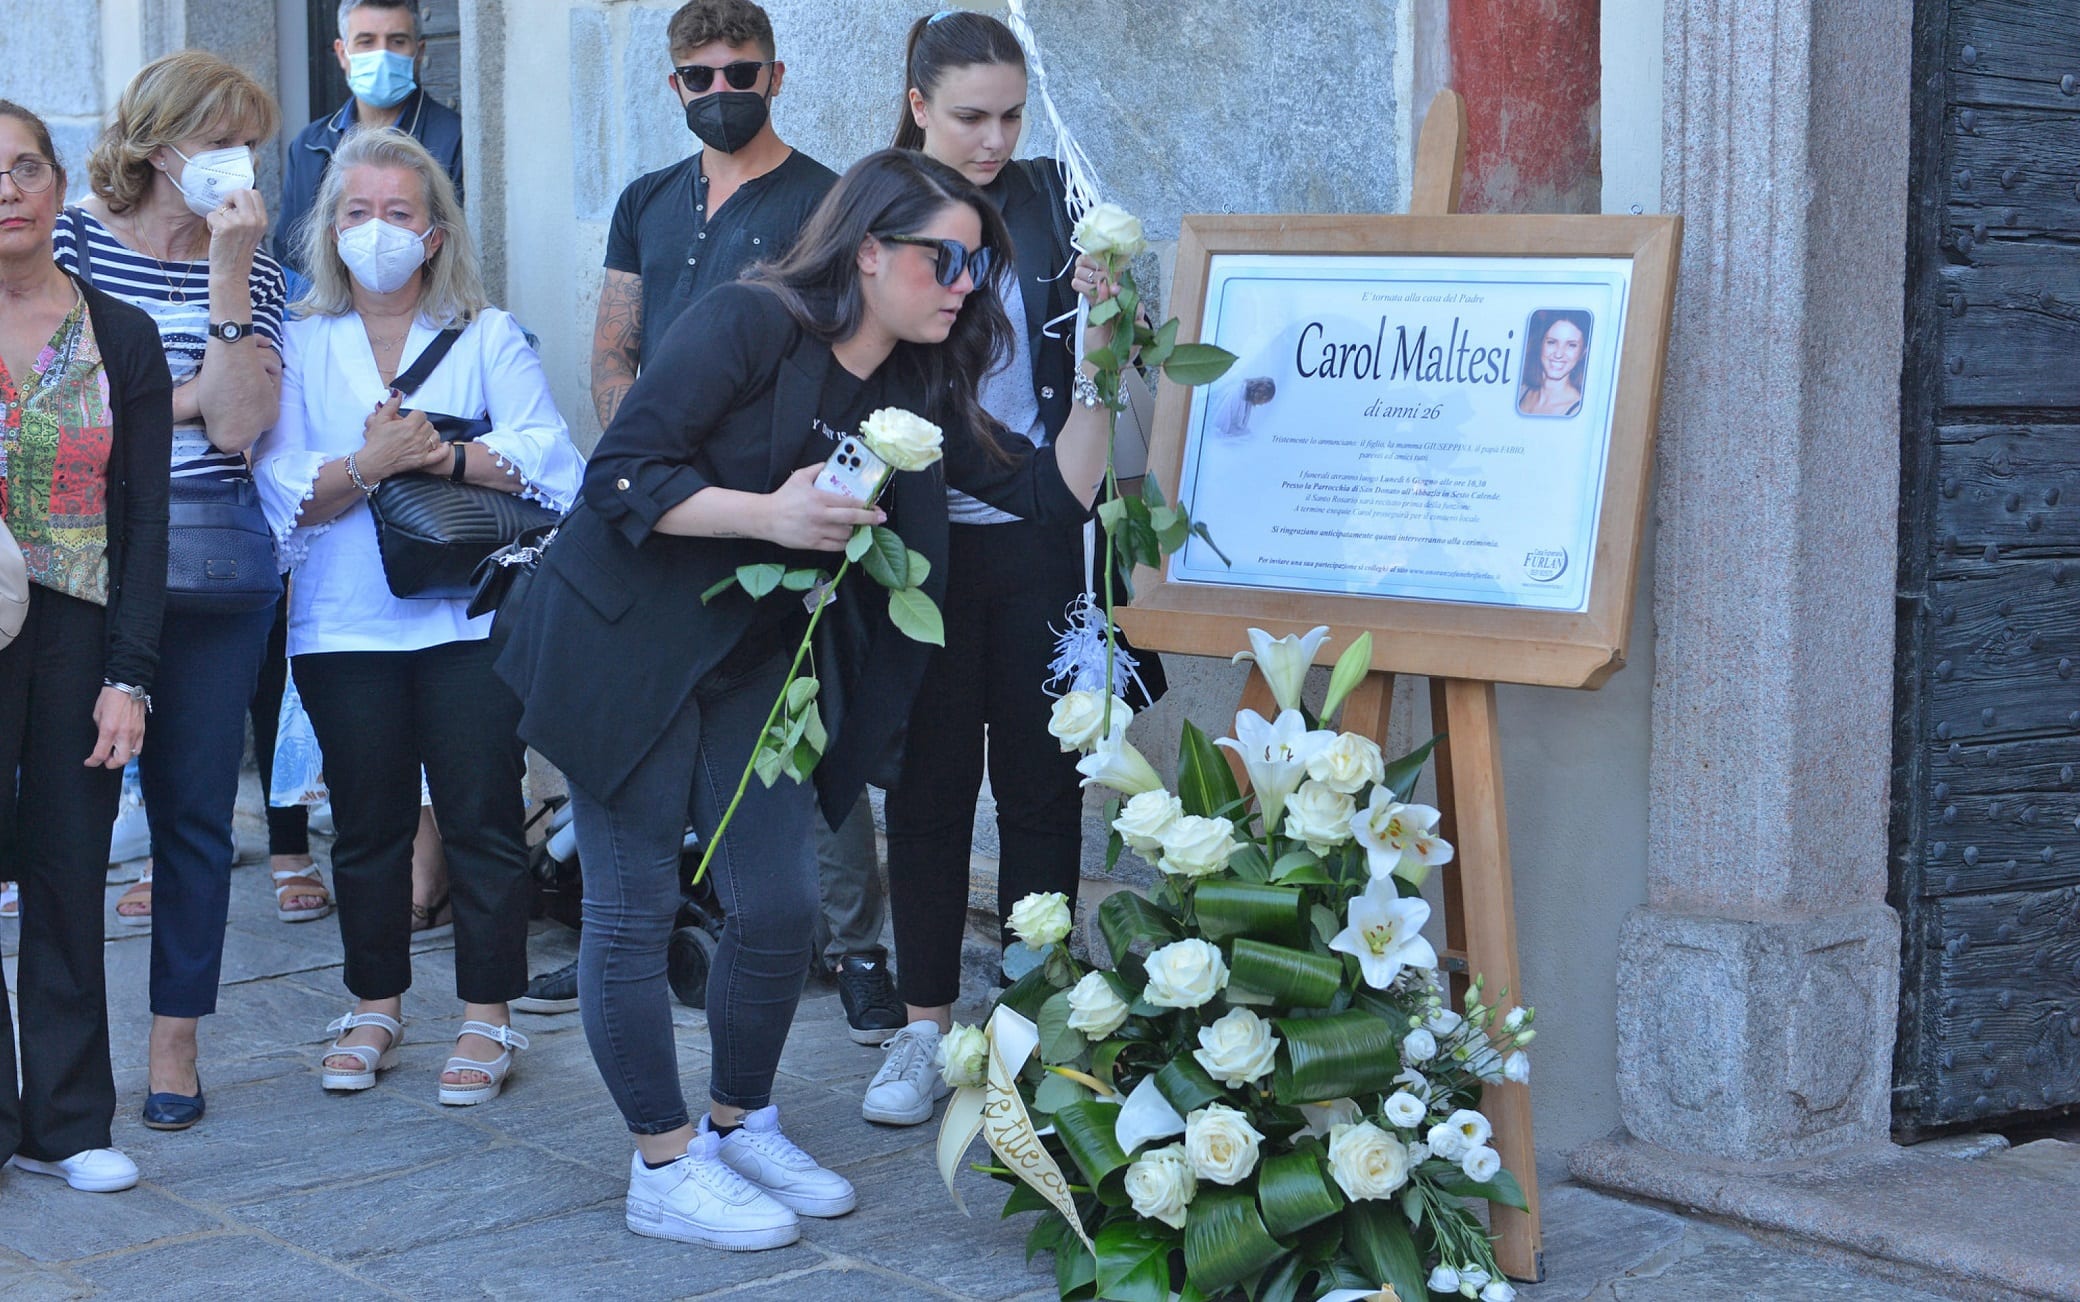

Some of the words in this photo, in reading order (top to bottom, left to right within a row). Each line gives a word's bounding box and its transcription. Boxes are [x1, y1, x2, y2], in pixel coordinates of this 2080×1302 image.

[1373, 292, 1402, 302] tornata
[1404, 292, 1420, 302] alla
[1422, 295, 1441, 303] casa
[1442, 293, 1458, 303] del
[1459, 293, 1485, 304] Padre
[1296, 315, 1387, 381] Carol
[1390, 316, 1514, 384] Maltesi
[1364, 398, 1382, 417] di
[1382, 402, 1421, 419] anni
[1421, 403, 1444, 420] 26
[1272, 435, 1309, 444] Tristemente
[1360, 439, 1366, 448] il
[1387, 440, 1395, 449] la
[1394, 453, 1413, 461] amici
[1302, 471, 1330, 480] funerali
[1330, 474, 1358, 482] avranno
[1412, 476, 1439, 486] Giugno
[1439, 478, 1453, 486] alle
[1282, 481, 1304, 490] Presso
[1304, 482, 1312, 490] la
[1313, 483, 1350, 492] Parrocchia
[1351, 484, 1359, 492] di
[1359, 485, 1373, 493] San
[1442, 489, 1450, 497] in
[1450, 490, 1470, 499] Sesto
[1312, 494, 1331, 502] Santo
[1332, 495, 1358, 504] Rosario
[1300, 505, 1326, 514] termine
[1352, 508, 1372, 516] Carol
[1409, 512, 1422, 520] per
[1272, 525, 1279, 533] Si
[1280, 526, 1319, 536] ringraziano
[1319, 529, 1374, 539] anticipatamente
[1374, 533, 1397, 542] quanti
[1398, 534, 1446, 545] interverranno
[1447, 537, 1461, 545] alla
[1258, 556, 1269, 564] Per
[1269, 557, 1290, 565] inviare
[1314, 561, 1358, 571] partecipazione
[1389, 565, 1397, 573] al
[1523, 552, 1562, 569] FURLAN
